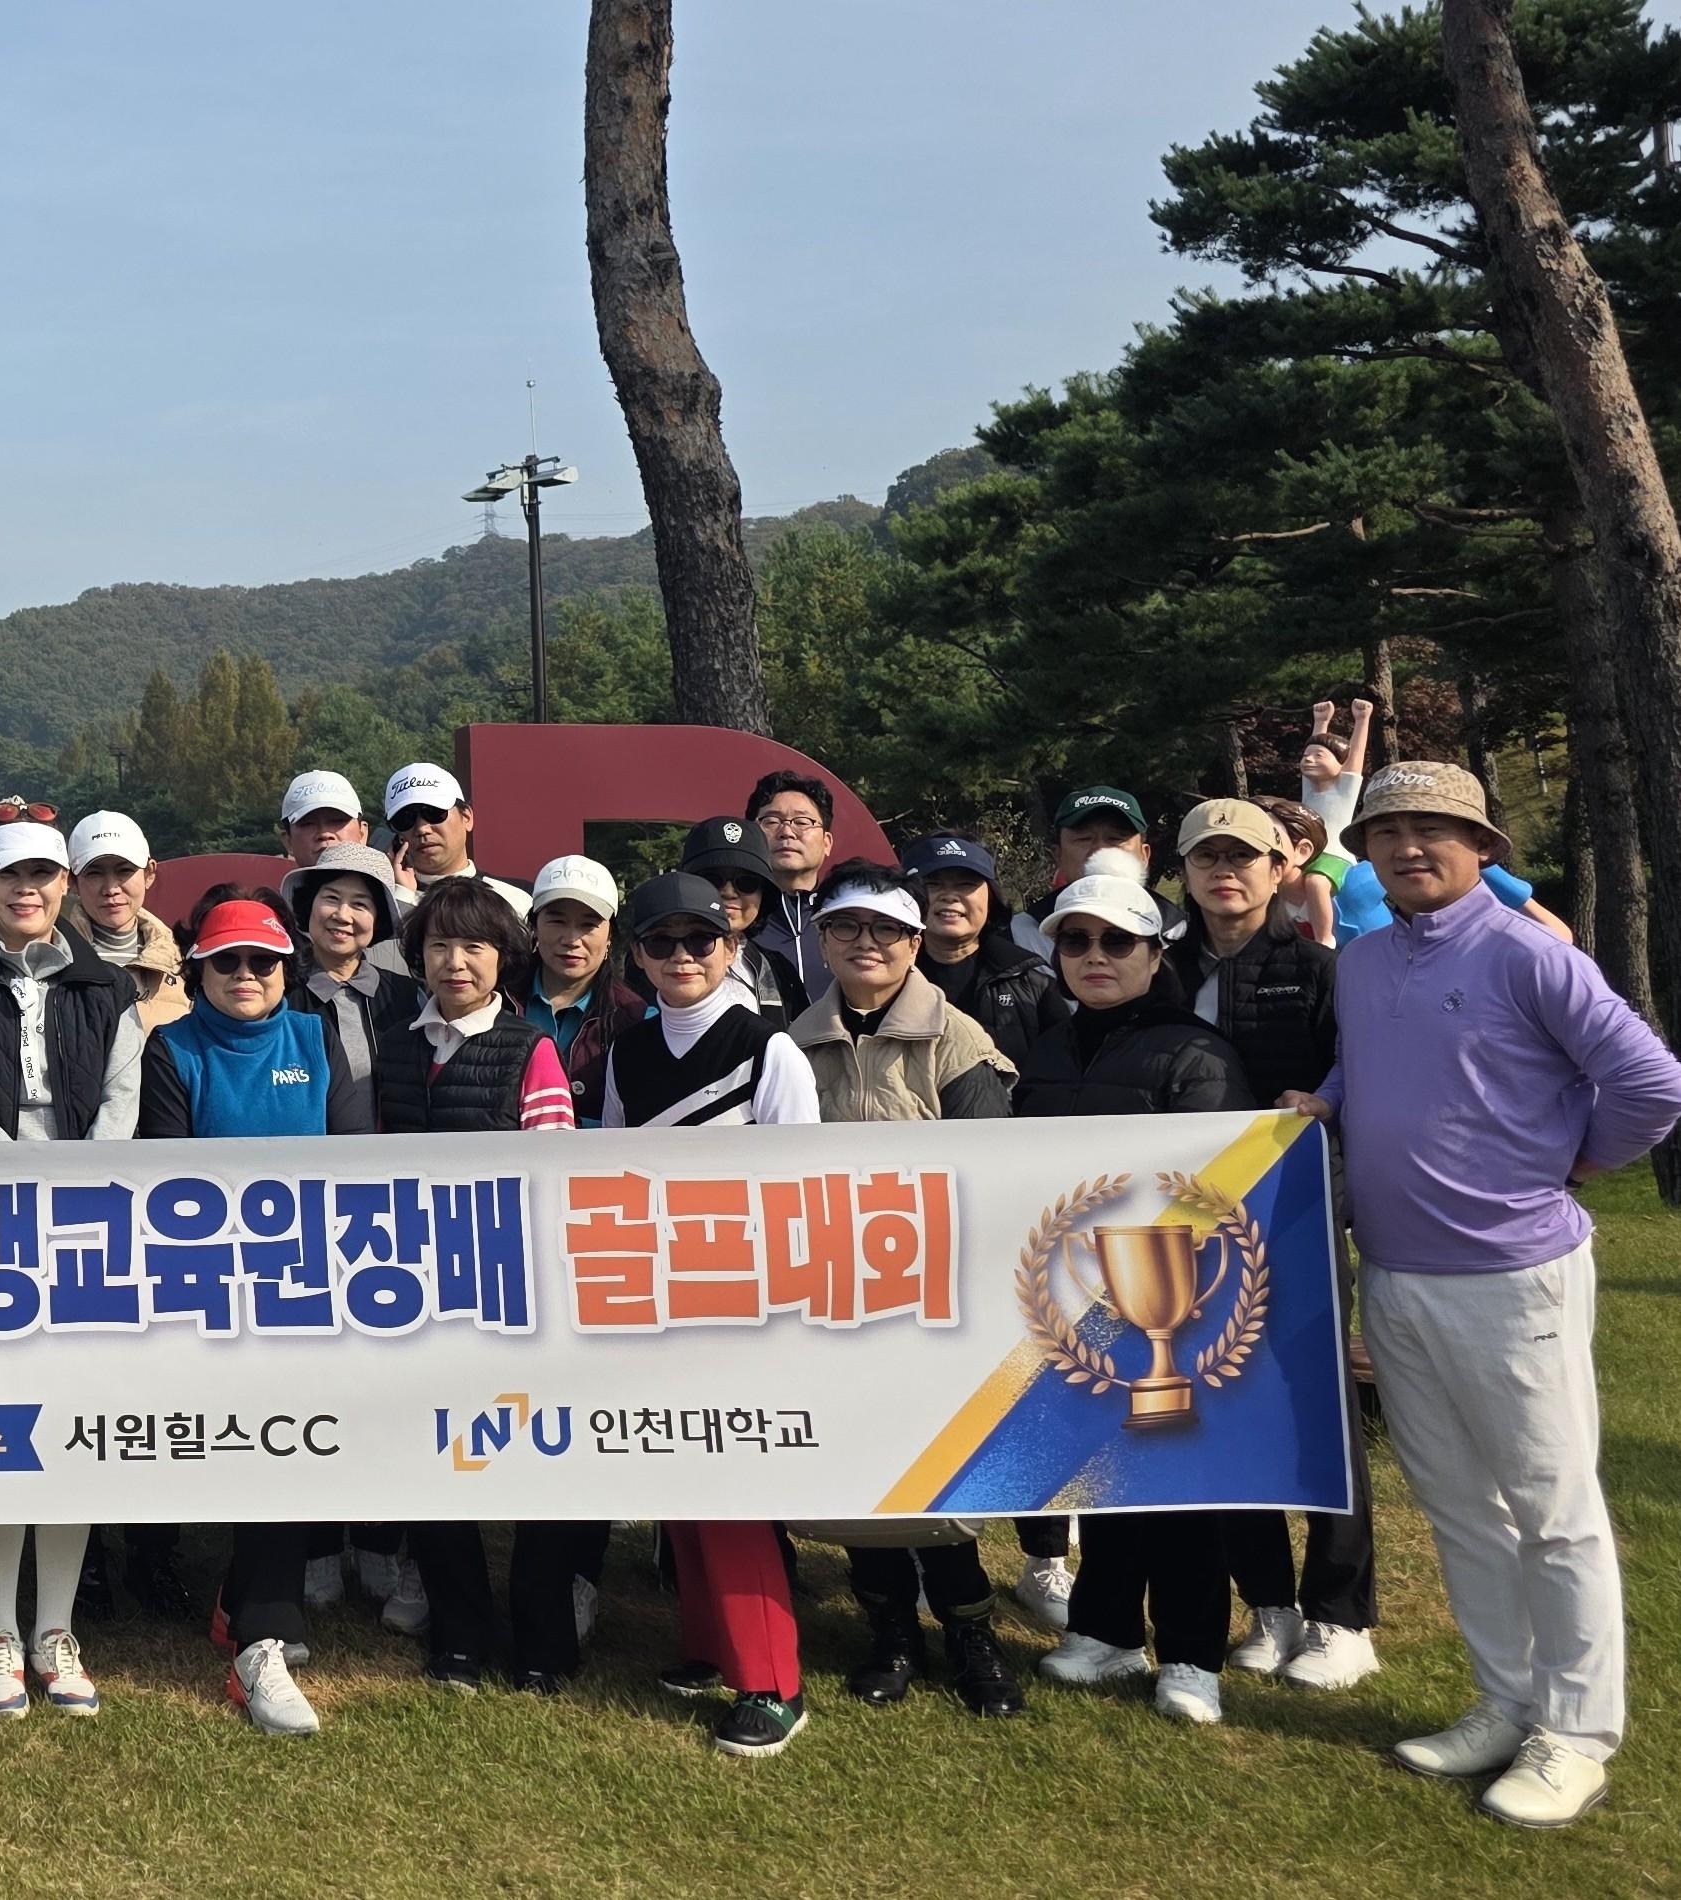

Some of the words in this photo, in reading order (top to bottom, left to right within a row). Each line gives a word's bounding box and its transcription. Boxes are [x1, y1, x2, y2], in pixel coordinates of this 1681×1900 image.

[390, 776, 440, 800] Titleist
[271, 1068, 310, 1086] PARIS
[565, 1170, 952, 1326] 골프대회
[64, 1411, 341, 1462] 서원힐스CC
[436, 1406, 572, 1457] INU
[589, 1406, 820, 1454] 인천대학교
